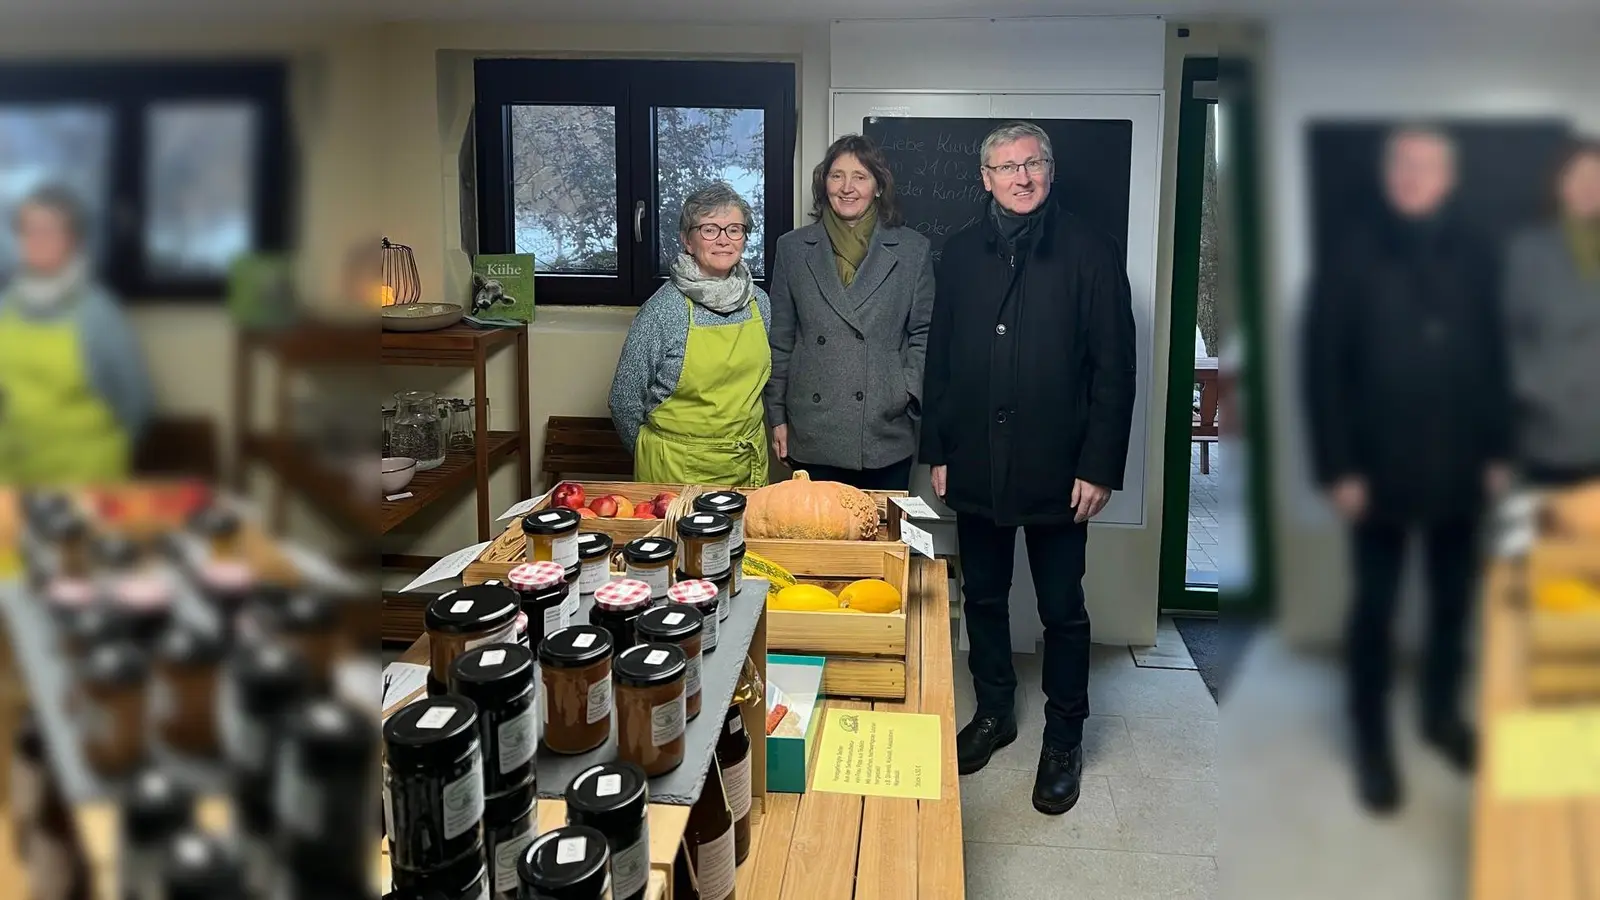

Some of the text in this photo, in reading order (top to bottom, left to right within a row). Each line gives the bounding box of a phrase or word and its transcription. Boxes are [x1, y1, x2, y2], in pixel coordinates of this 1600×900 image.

[879, 131, 925, 151] Liebe
[896, 181, 923, 196] eder
[487, 263, 522, 275] Kühe
